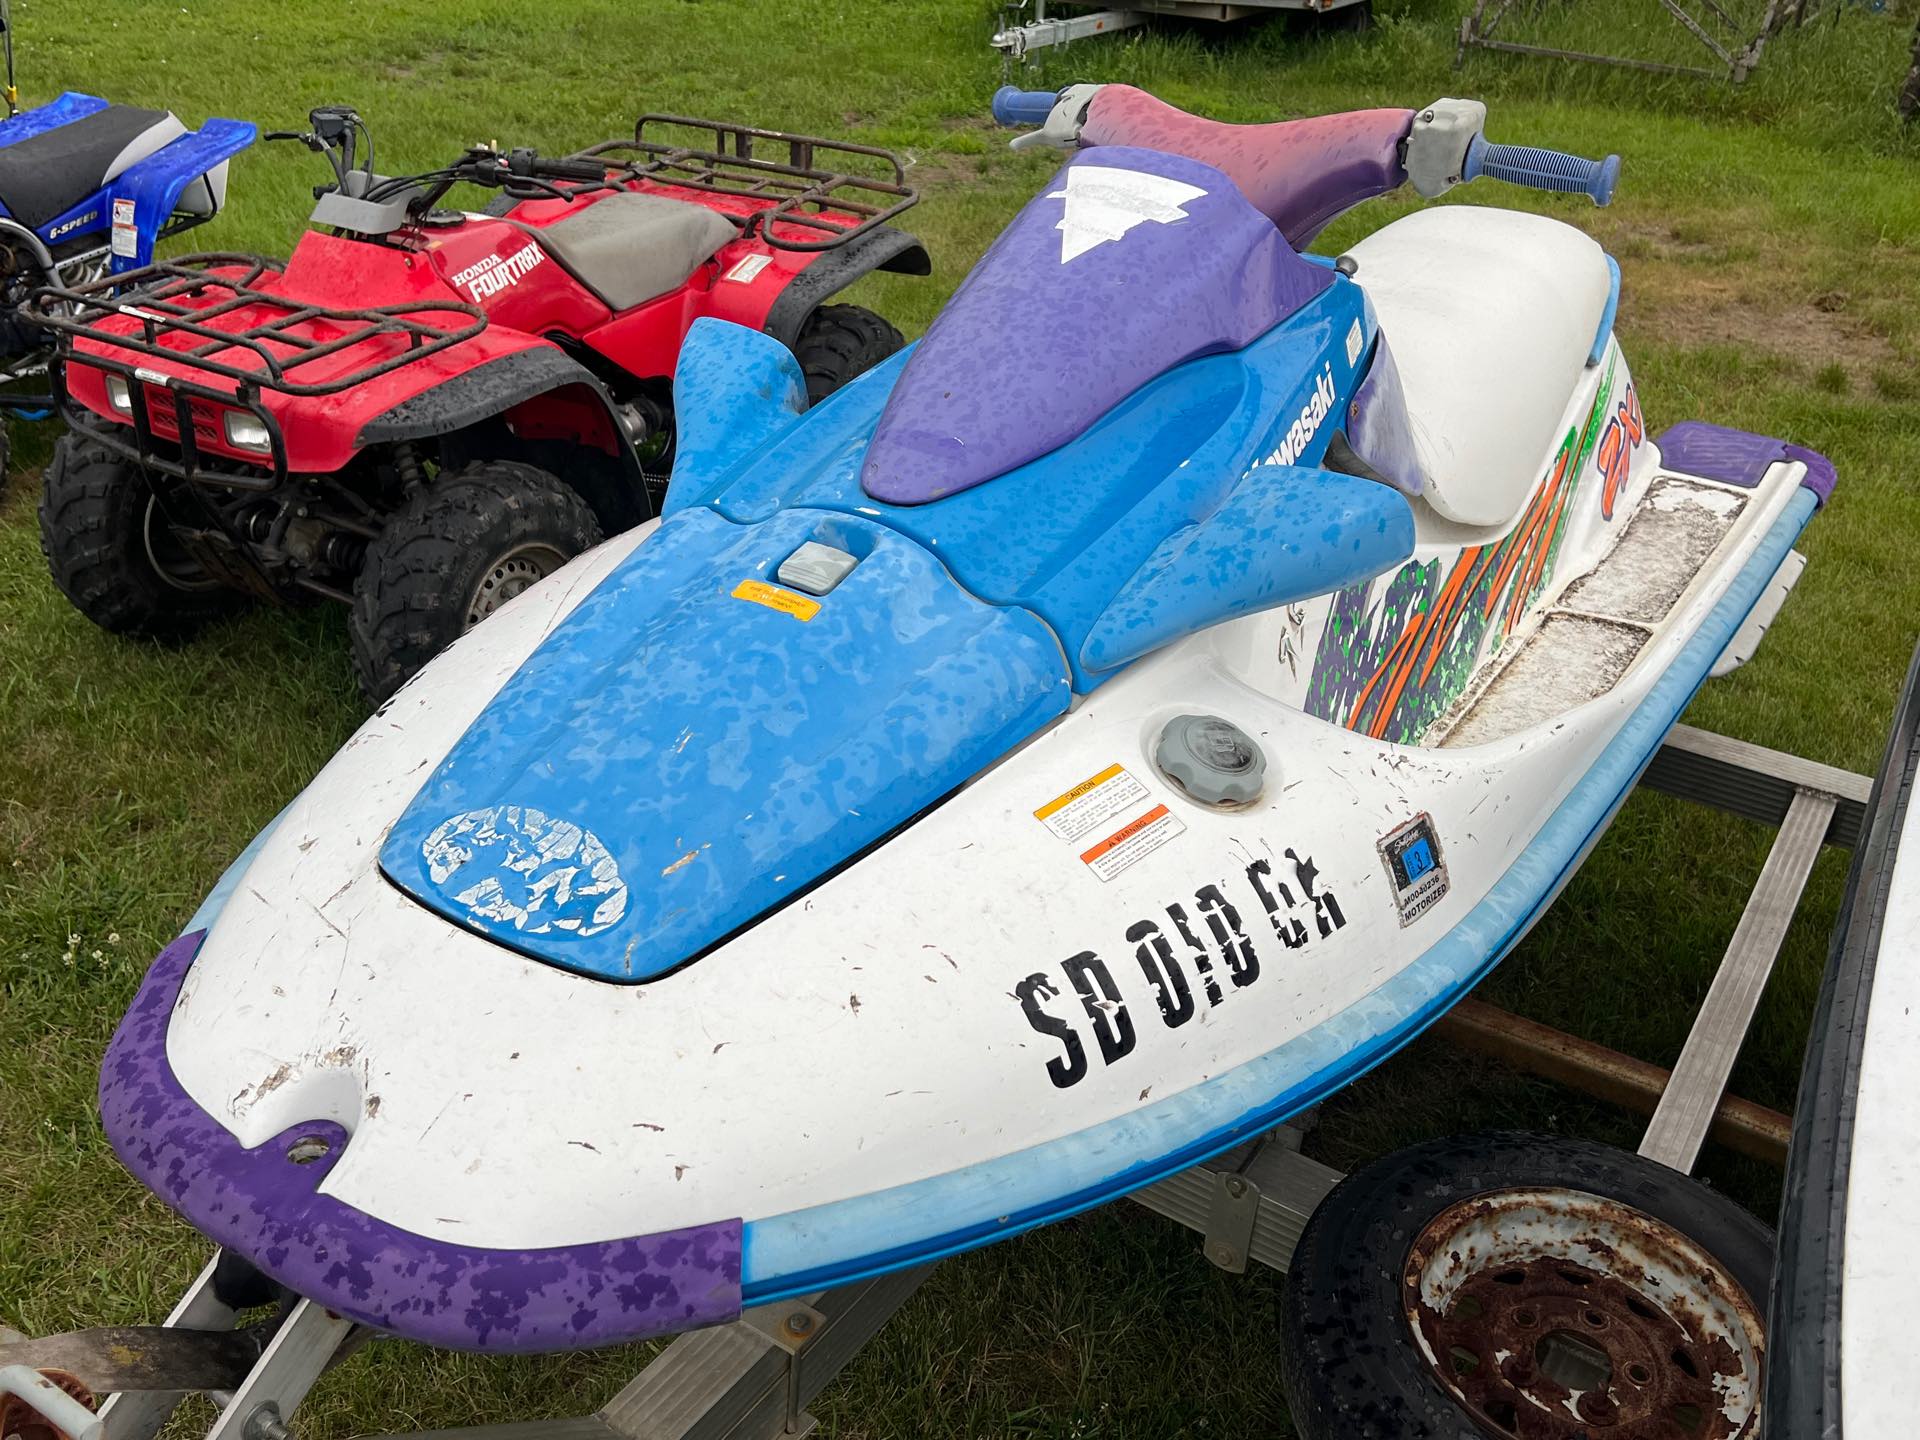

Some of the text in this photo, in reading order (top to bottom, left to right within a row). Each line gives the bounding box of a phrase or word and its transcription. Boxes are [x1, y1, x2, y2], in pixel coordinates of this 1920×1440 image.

[50, 211, 98, 239] 6-SPEED
[451, 253, 502, 287] HONDA
[467, 241, 545, 303] FOURTRAX
[1065, 780, 1096, 801] CAUTION
[1114, 819, 1147, 844] WARNING
[1404, 884, 1447, 921] MOTORIZED
[1014, 950, 1137, 1088] SD
